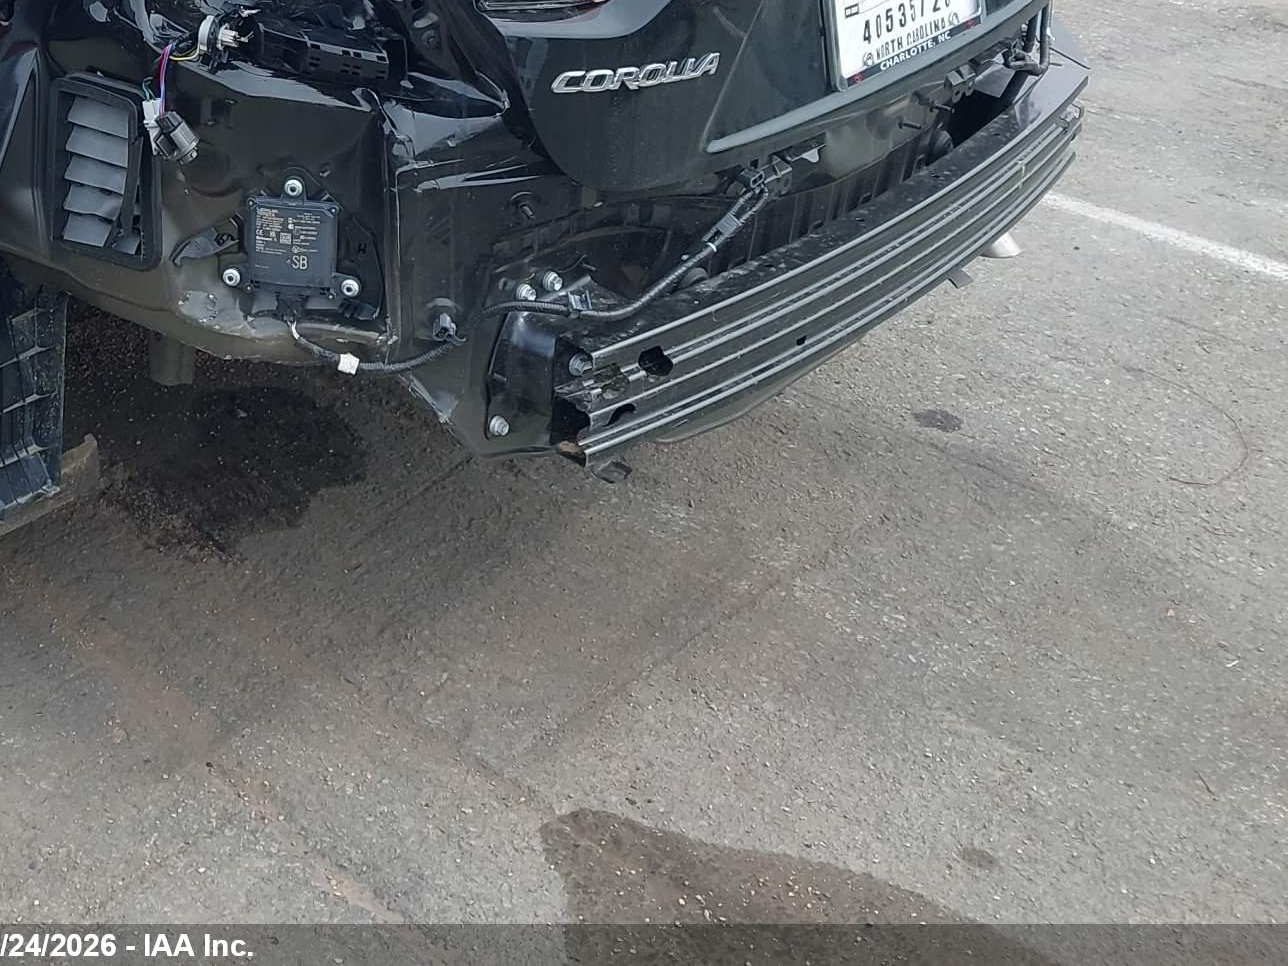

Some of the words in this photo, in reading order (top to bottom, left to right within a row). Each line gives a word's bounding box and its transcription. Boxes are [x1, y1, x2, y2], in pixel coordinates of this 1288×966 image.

[876, 36, 904, 61] NORTH
[906, 17, 946, 46] CAROLINA
[880, 39, 936, 71] CHARLOTTE,
[938, 31, 952, 43] NC
[550, 52, 721, 94] COROLLA
[291, 255, 308, 270] SB
